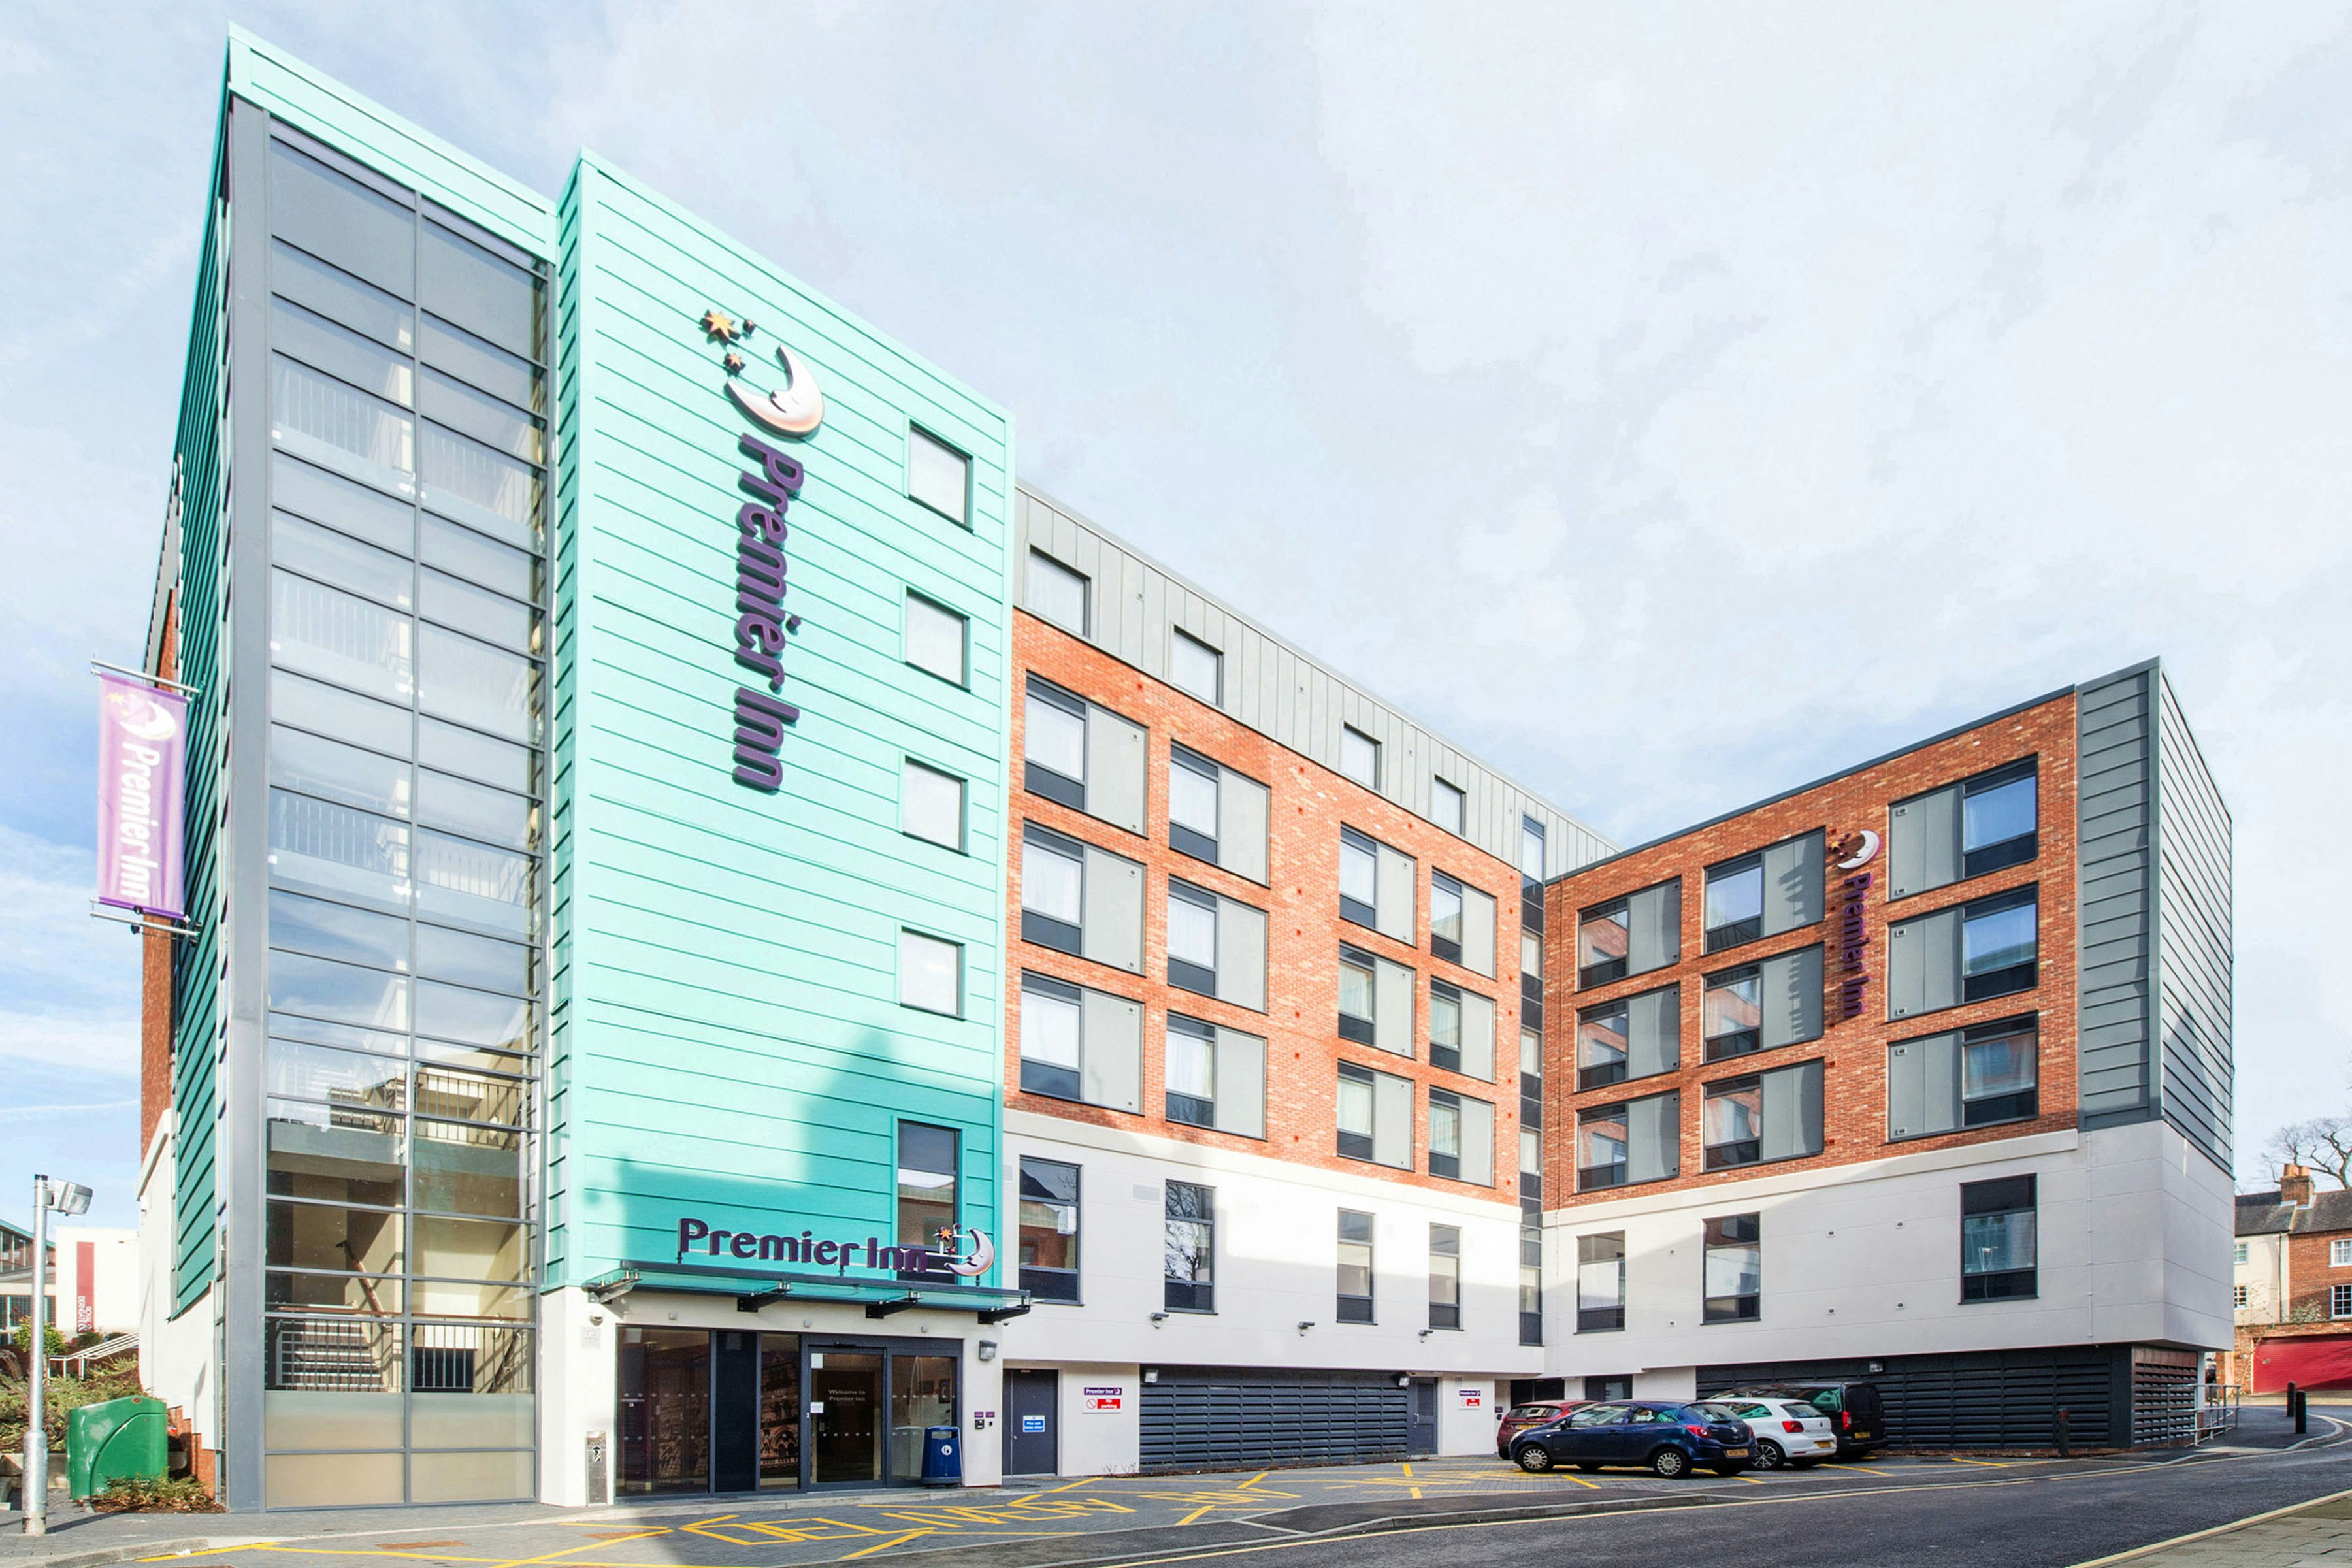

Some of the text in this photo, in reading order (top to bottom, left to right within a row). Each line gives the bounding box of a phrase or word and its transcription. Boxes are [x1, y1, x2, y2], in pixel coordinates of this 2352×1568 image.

[732, 433, 804, 795] Premier Inn
[120, 742, 161, 900] Premier Inn
[1842, 872, 1872, 1018] Premier Inn
[678, 1218, 927, 1274] Premier Inn
[679, 1499, 1137, 1545] DELIVERY
[1138, 1488, 1302, 1504] BAY
